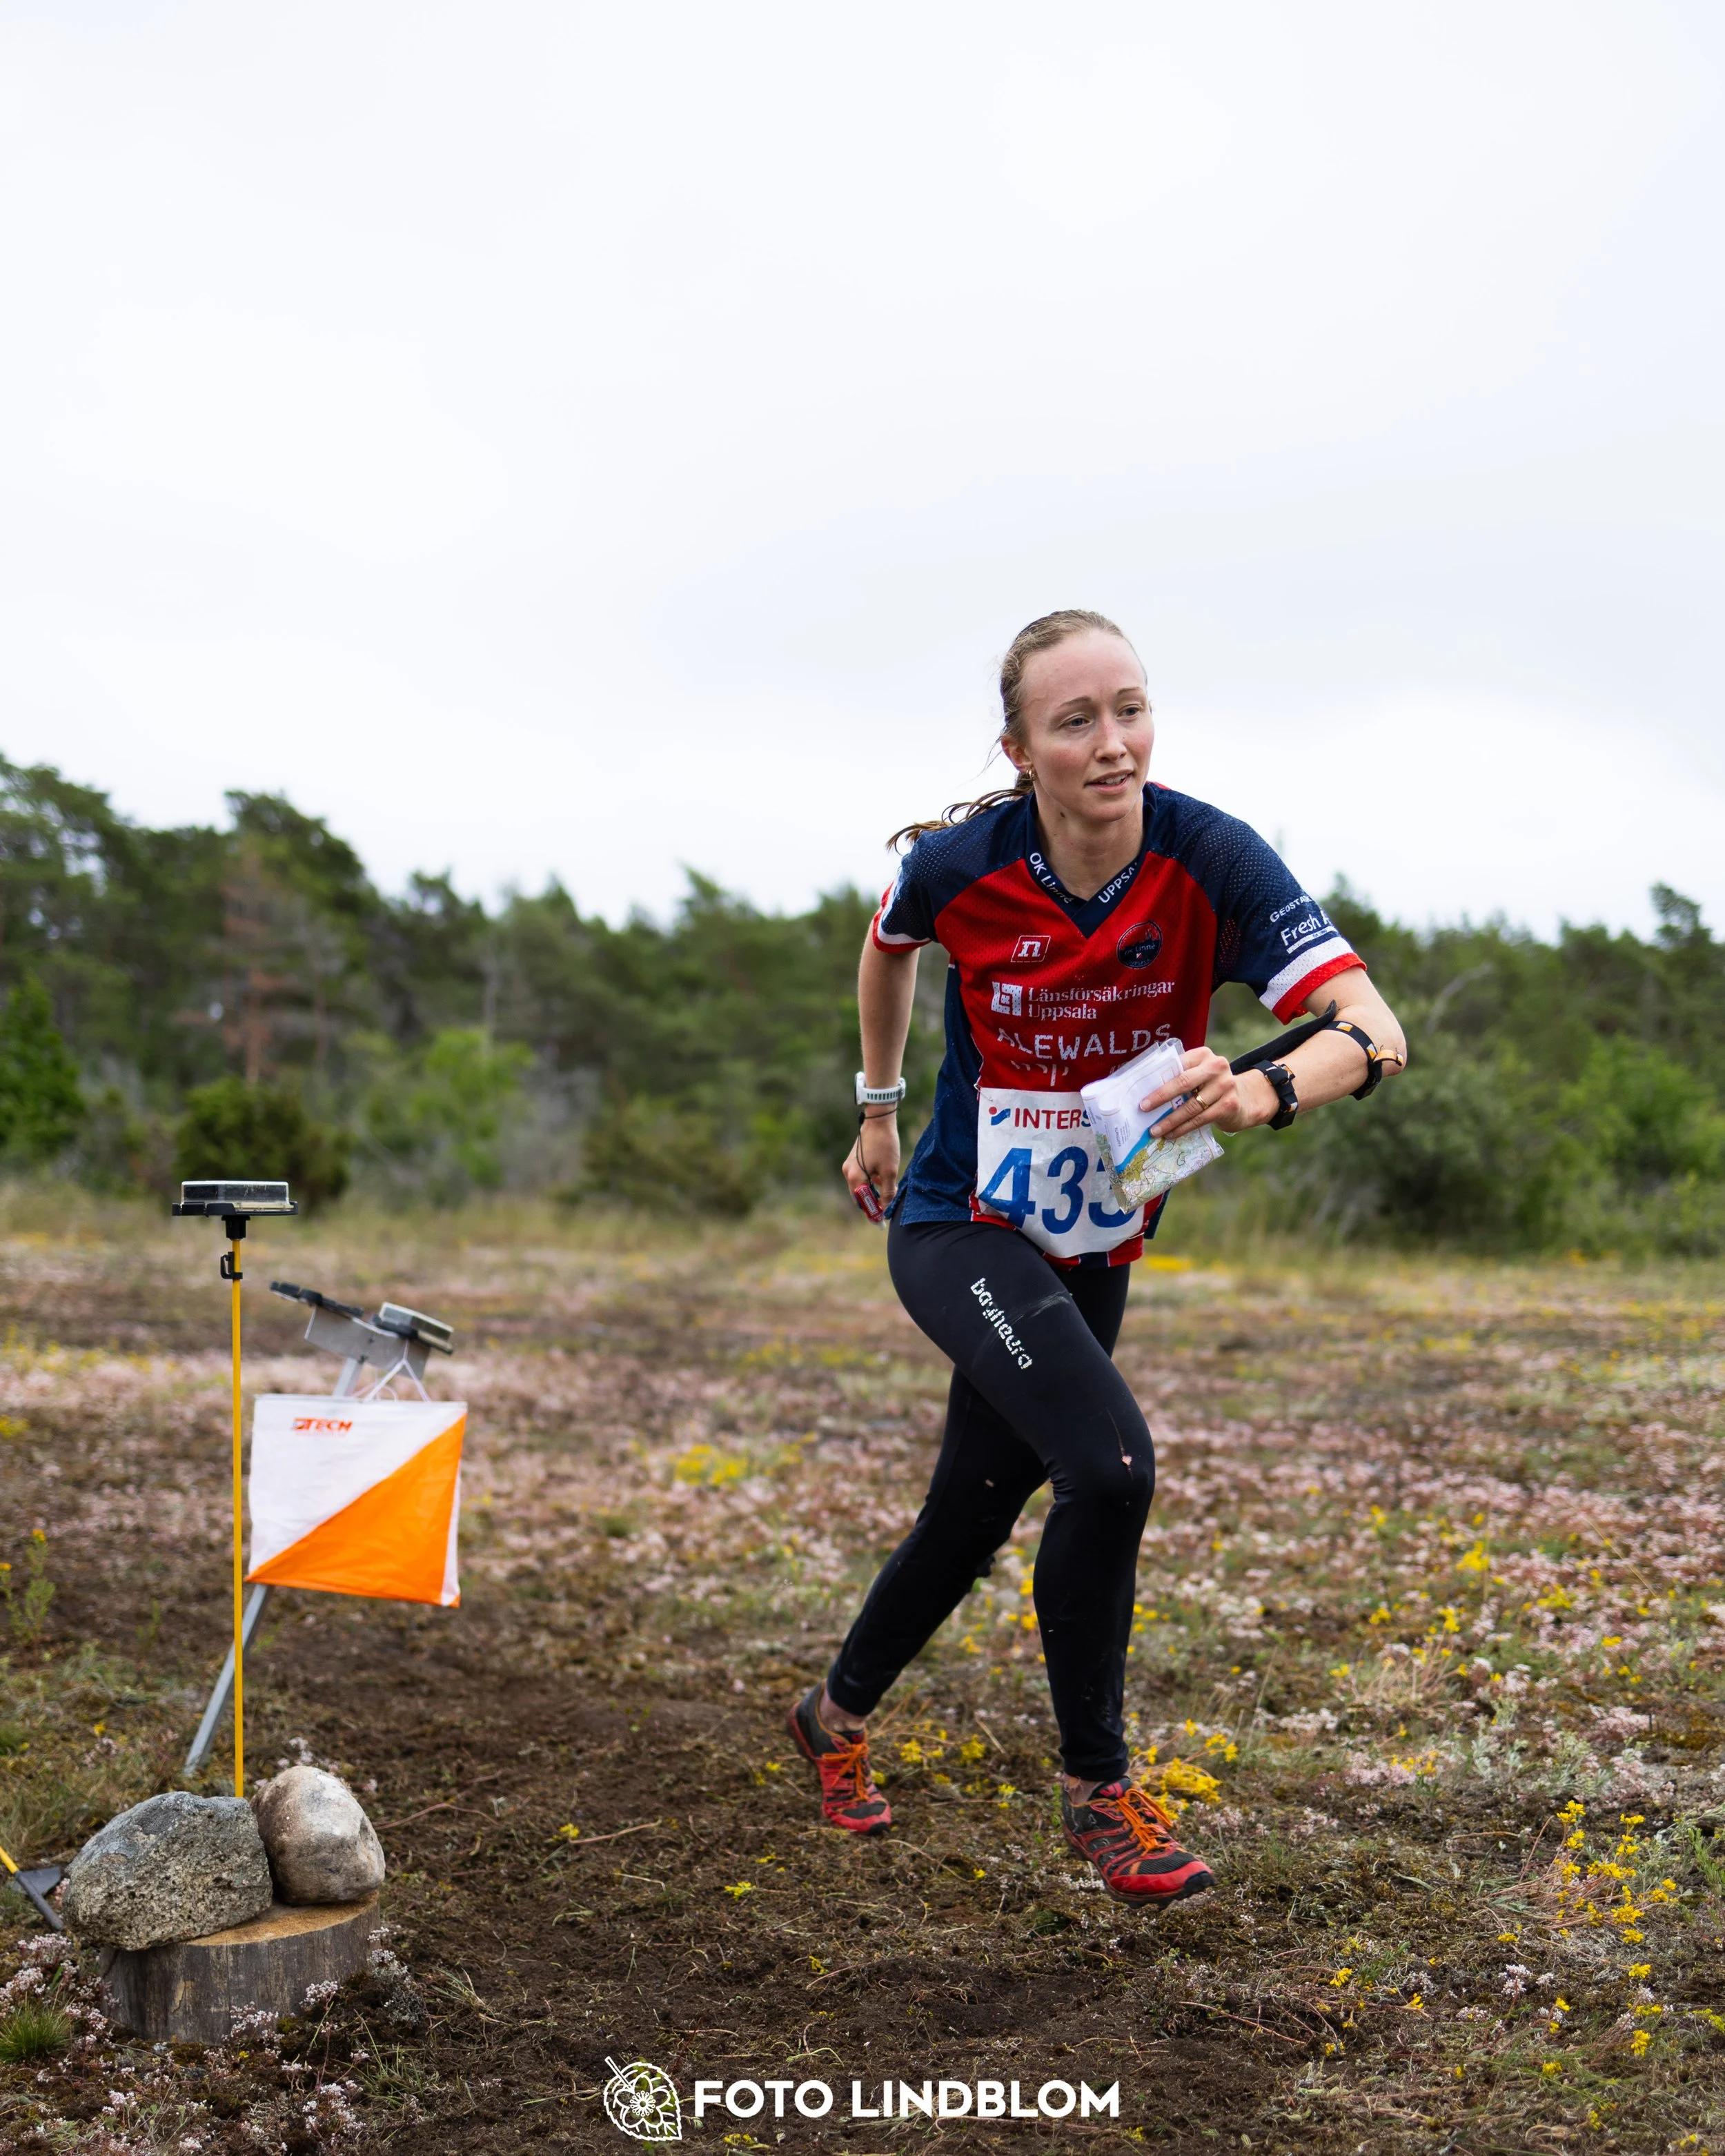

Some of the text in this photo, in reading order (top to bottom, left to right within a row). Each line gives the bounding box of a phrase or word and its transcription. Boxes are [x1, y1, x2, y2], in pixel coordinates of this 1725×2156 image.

[1029, 852, 1047, 876] OK
[1098, 862, 1137, 903] UPPSA
[1280, 914, 1322, 947] Fresh
[1028, 981, 1176, 1002] Länsförsäkringar
[1028, 1004, 1097, 1021] Uppsala
[997, 1023, 1172, 1060] ALEWALDS
[1014, 1107, 1092, 1129] INTERS
